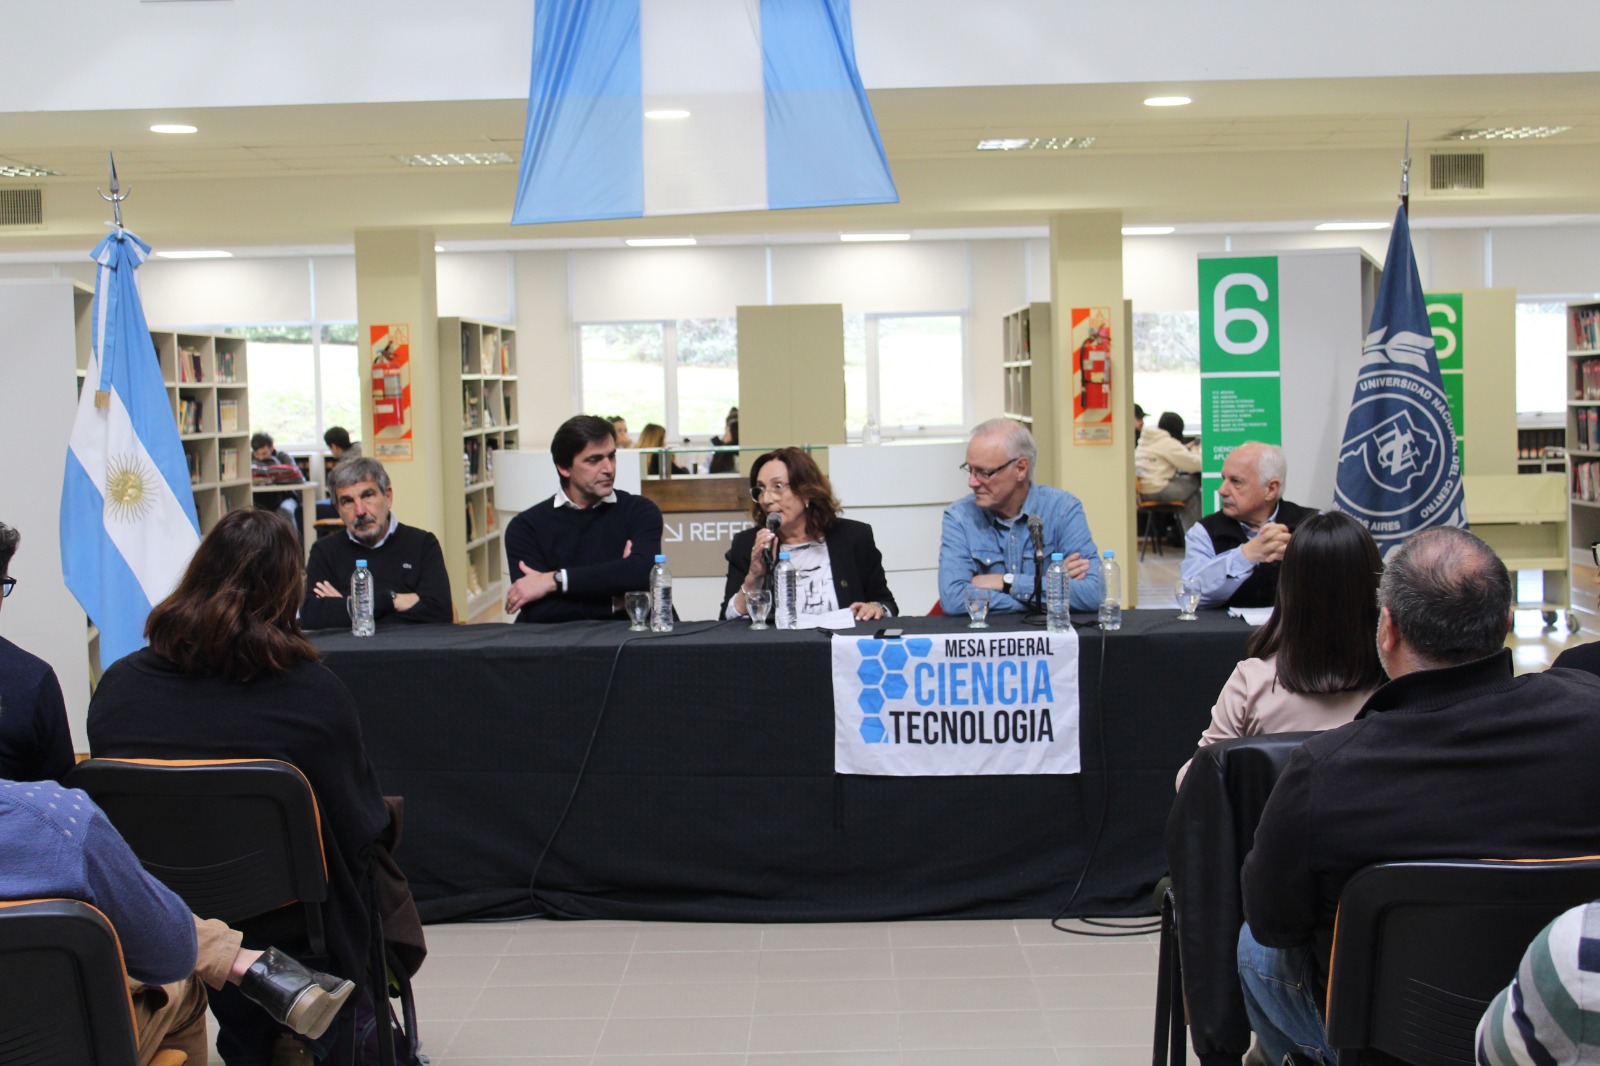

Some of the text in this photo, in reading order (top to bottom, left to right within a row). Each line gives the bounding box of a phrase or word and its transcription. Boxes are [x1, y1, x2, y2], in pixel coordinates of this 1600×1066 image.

[1213, 272, 1269, 355] 6
[1360, 377, 1432, 400] UNIVERSIDAD
[1450, 455, 1460, 477] DEL
[1420, 481, 1454, 519] CENTRO
[1370, 520, 1400, 532] AIRES
[945, 637, 1055, 657] MESA FEDERAL
[914, 660, 1054, 706] CIENCIA
[889, 709, 1054, 744] TECNOLOGIA
